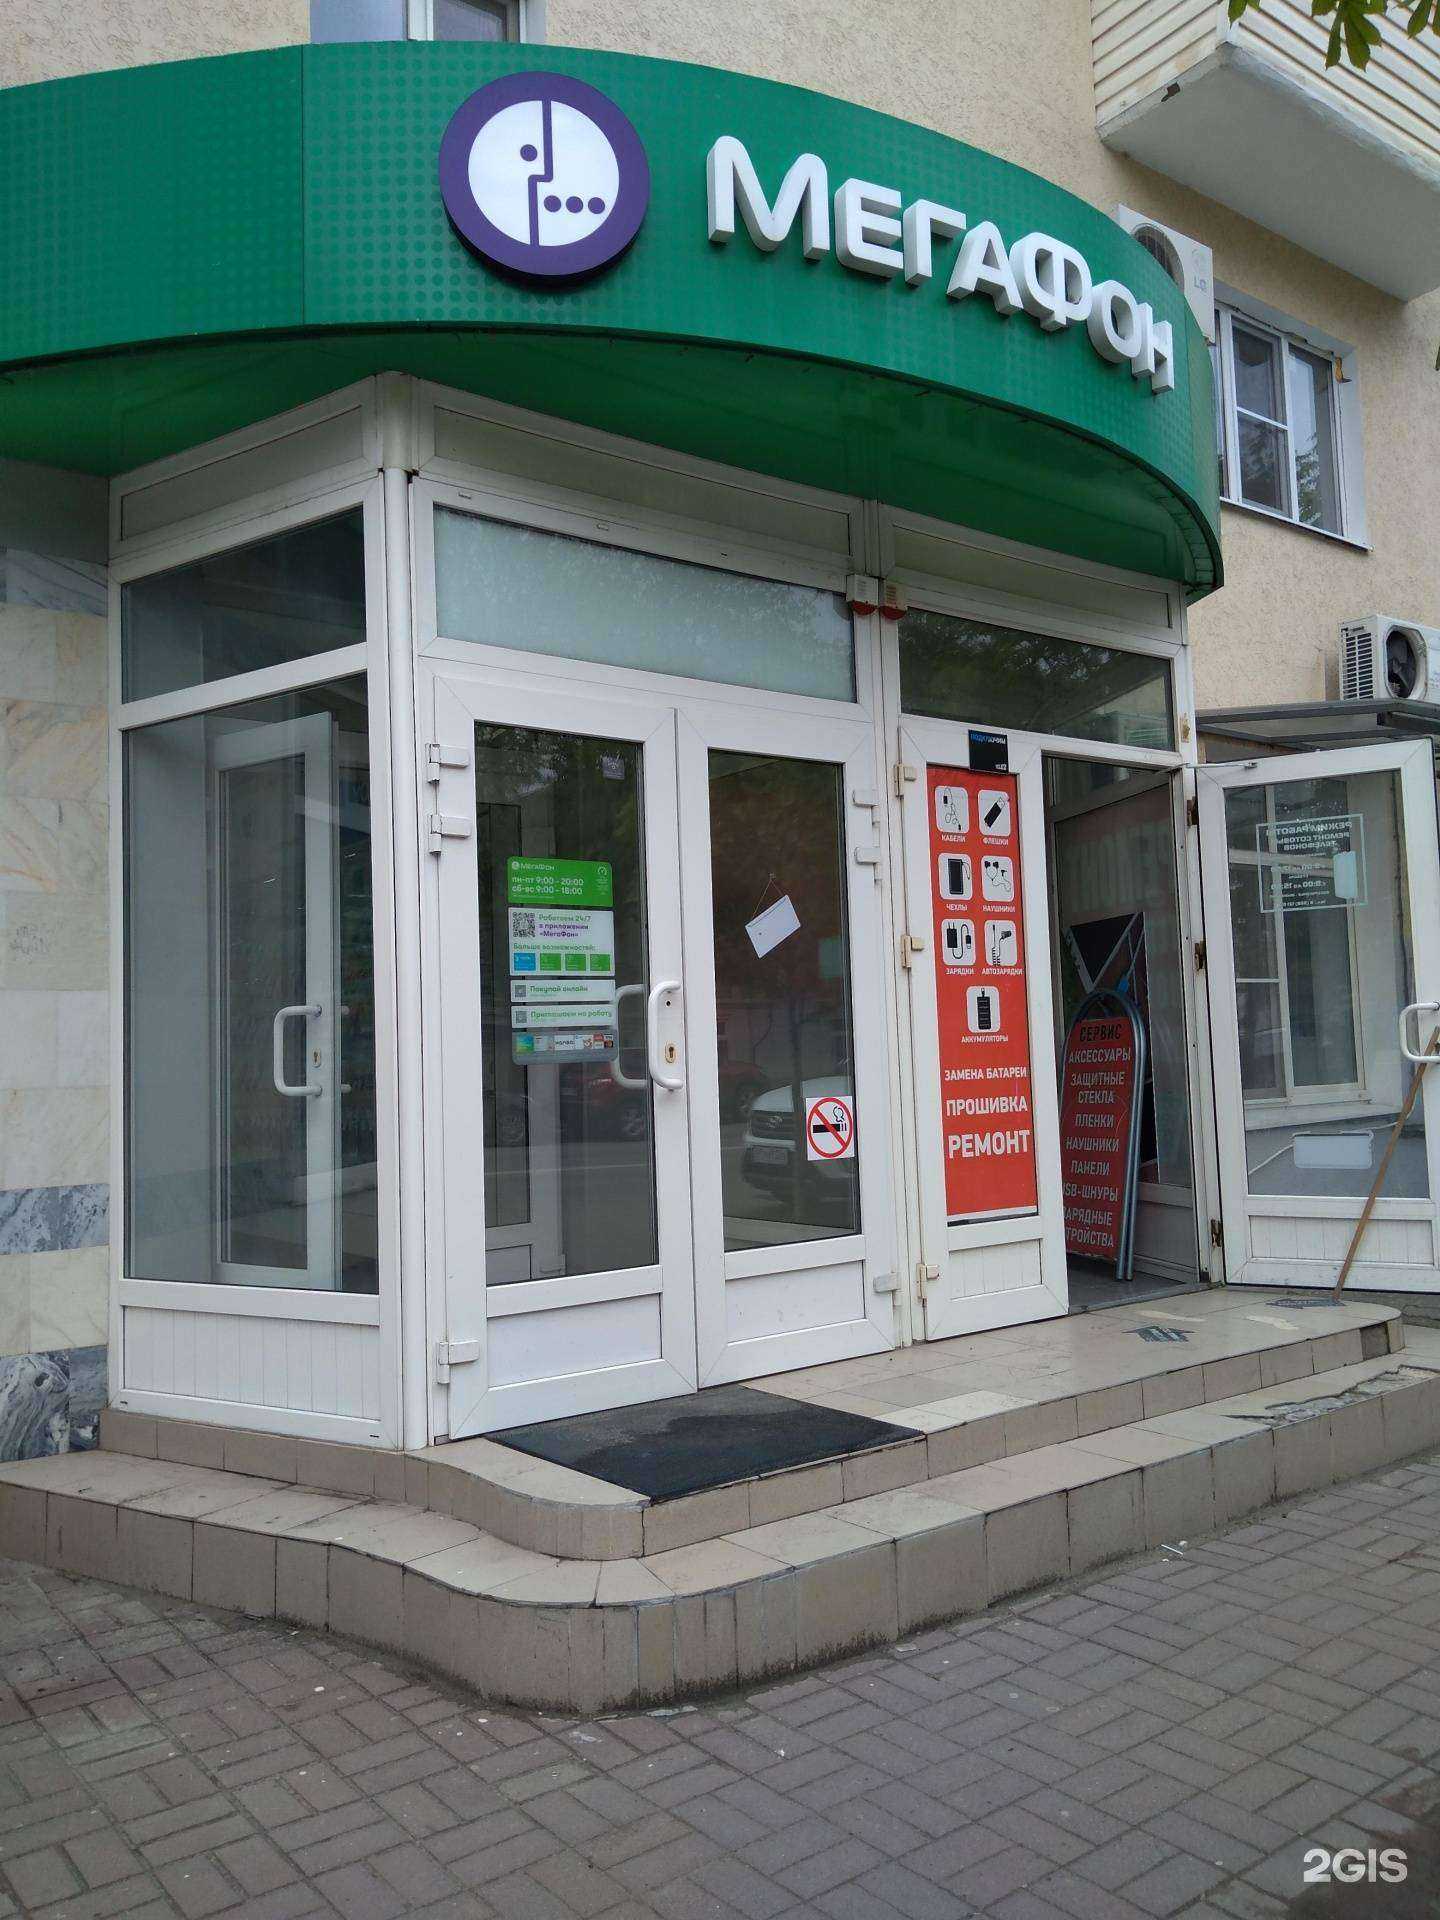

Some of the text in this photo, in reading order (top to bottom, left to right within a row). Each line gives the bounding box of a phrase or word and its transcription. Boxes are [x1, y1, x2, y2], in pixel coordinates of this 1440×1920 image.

[941, 834, 1009, 846] КАБЕЛИ ФЛЕШКИ
[537, 876, 555, 885] 9:00
[561, 878, 584, 886] 20:00
[537, 886, 555, 894] 9:00
[946, 903, 1016, 913] ЧЕХЛЫ НАУШНИКИ
[945, 967, 1024, 976] ЗАРЯДКИ АВТОЗАРЯДКИ
[961, 1035, 1009, 1044] АККУМУЛЯТОРЫ
[1080, 1023, 1123, 1042] СЕРВИС
[1068, 1047, 1132, 1064] АКСЕССУАРЫ
[944, 1068, 984, 1081] ЗАМЕНА
[1070, 1071, 1126, 1088] ЗАЩИТНЫЕ
[1078, 1090, 1115, 1104] СТЕКЛА
[946, 1095, 1028, 1117] ПРОШИВКА
[1075, 1113, 1115, 1129] ПЛЕНКИ
[948, 1129, 1031, 1159] РЕМОНТ
[1065, 1136, 1121, 1152] НАУШНИКИ
[1070, 1159, 1111, 1176] ПАНЕЛИ
[1065, 1227, 1114, 1248] ТРОЙСТВА
